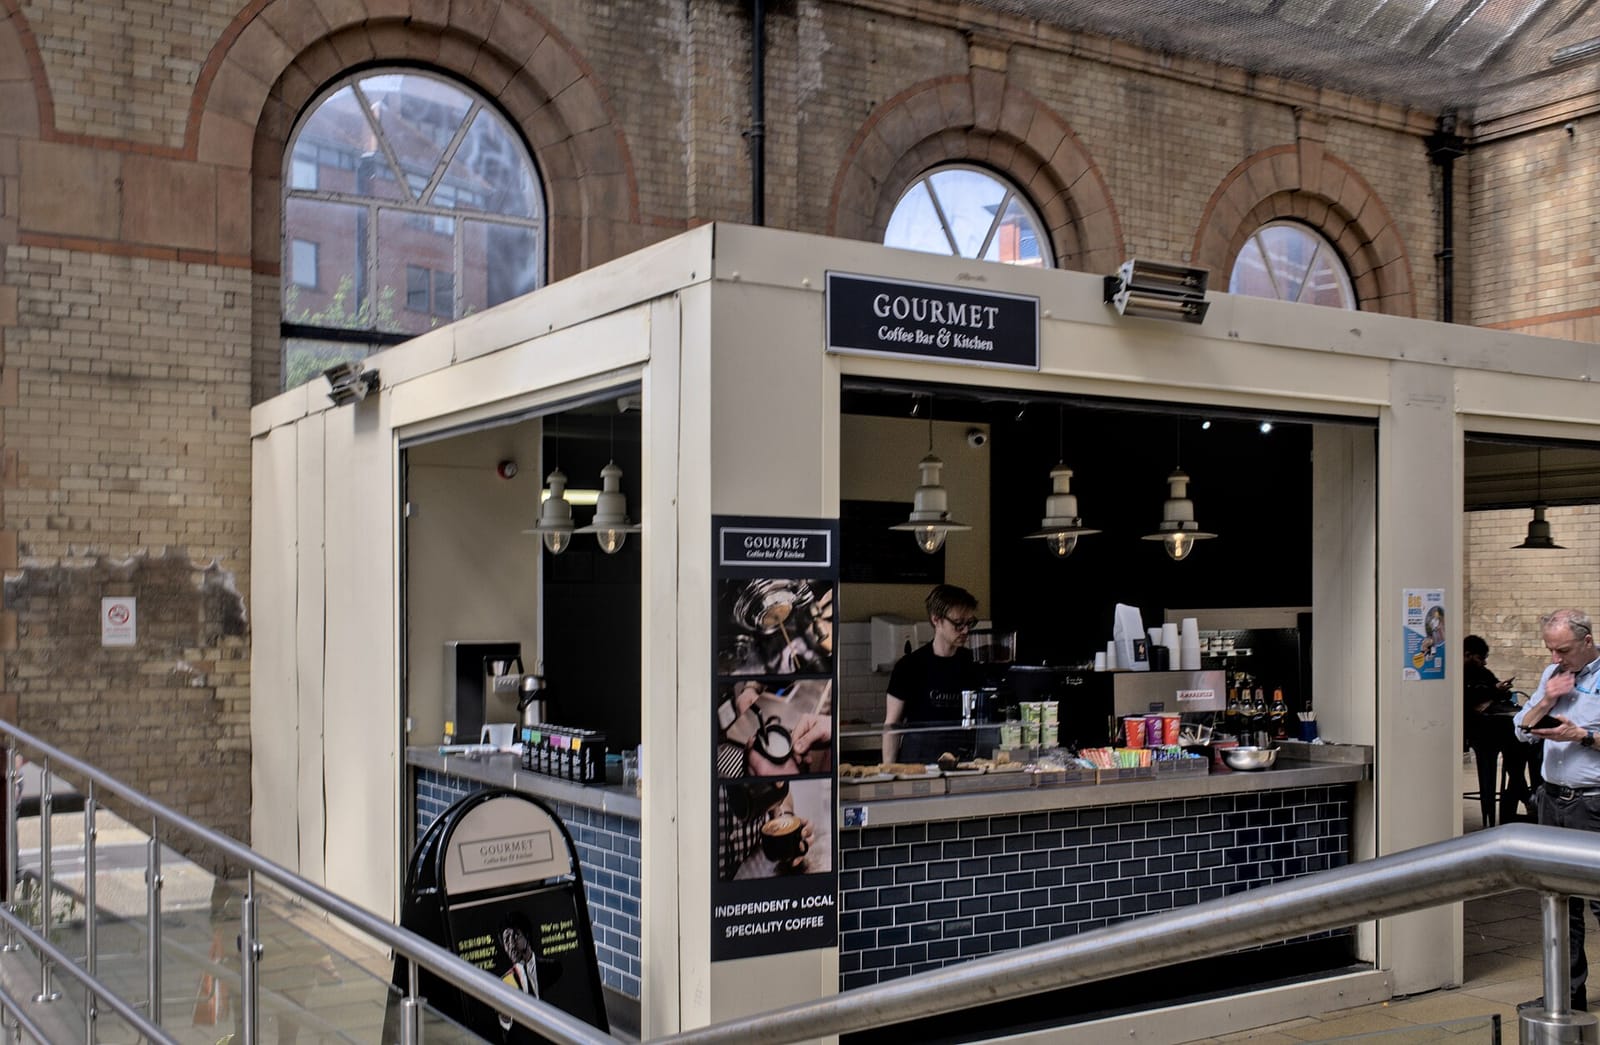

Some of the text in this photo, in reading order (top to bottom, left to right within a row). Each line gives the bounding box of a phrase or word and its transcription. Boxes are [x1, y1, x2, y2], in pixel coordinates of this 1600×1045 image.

[873, 293, 999, 330] GOURMET
[878, 325, 994, 351] Coffee Bar & Kitchen
[743, 536, 808, 550] GOURMET
[479, 838, 535, 856] GOURMET
[715, 894, 834, 918] INDEPENDENT LOCAL
[725, 915, 824, 938] SPECIALITY COFFEE
